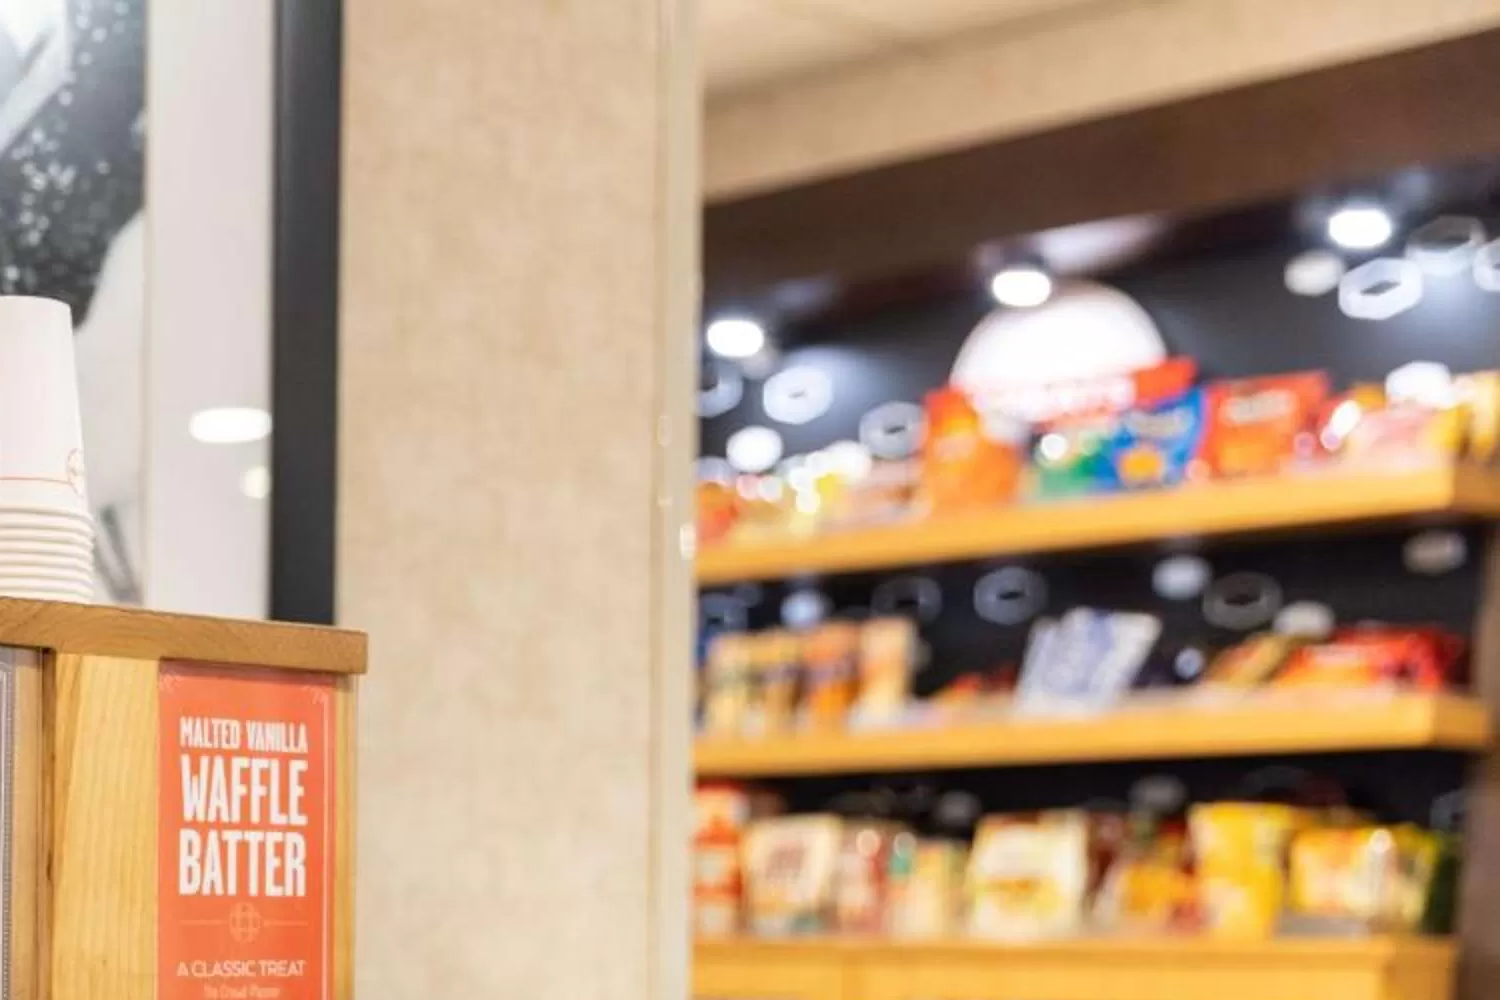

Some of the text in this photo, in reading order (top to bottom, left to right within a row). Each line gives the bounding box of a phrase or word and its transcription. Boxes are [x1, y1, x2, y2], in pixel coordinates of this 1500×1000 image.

[179, 716, 308, 754] MALTED VANILLA
[181, 754, 308, 825] WAFFLE
[178, 829, 306, 897] BATTER
[176, 959, 307, 978] A CLASSIC TREAT
